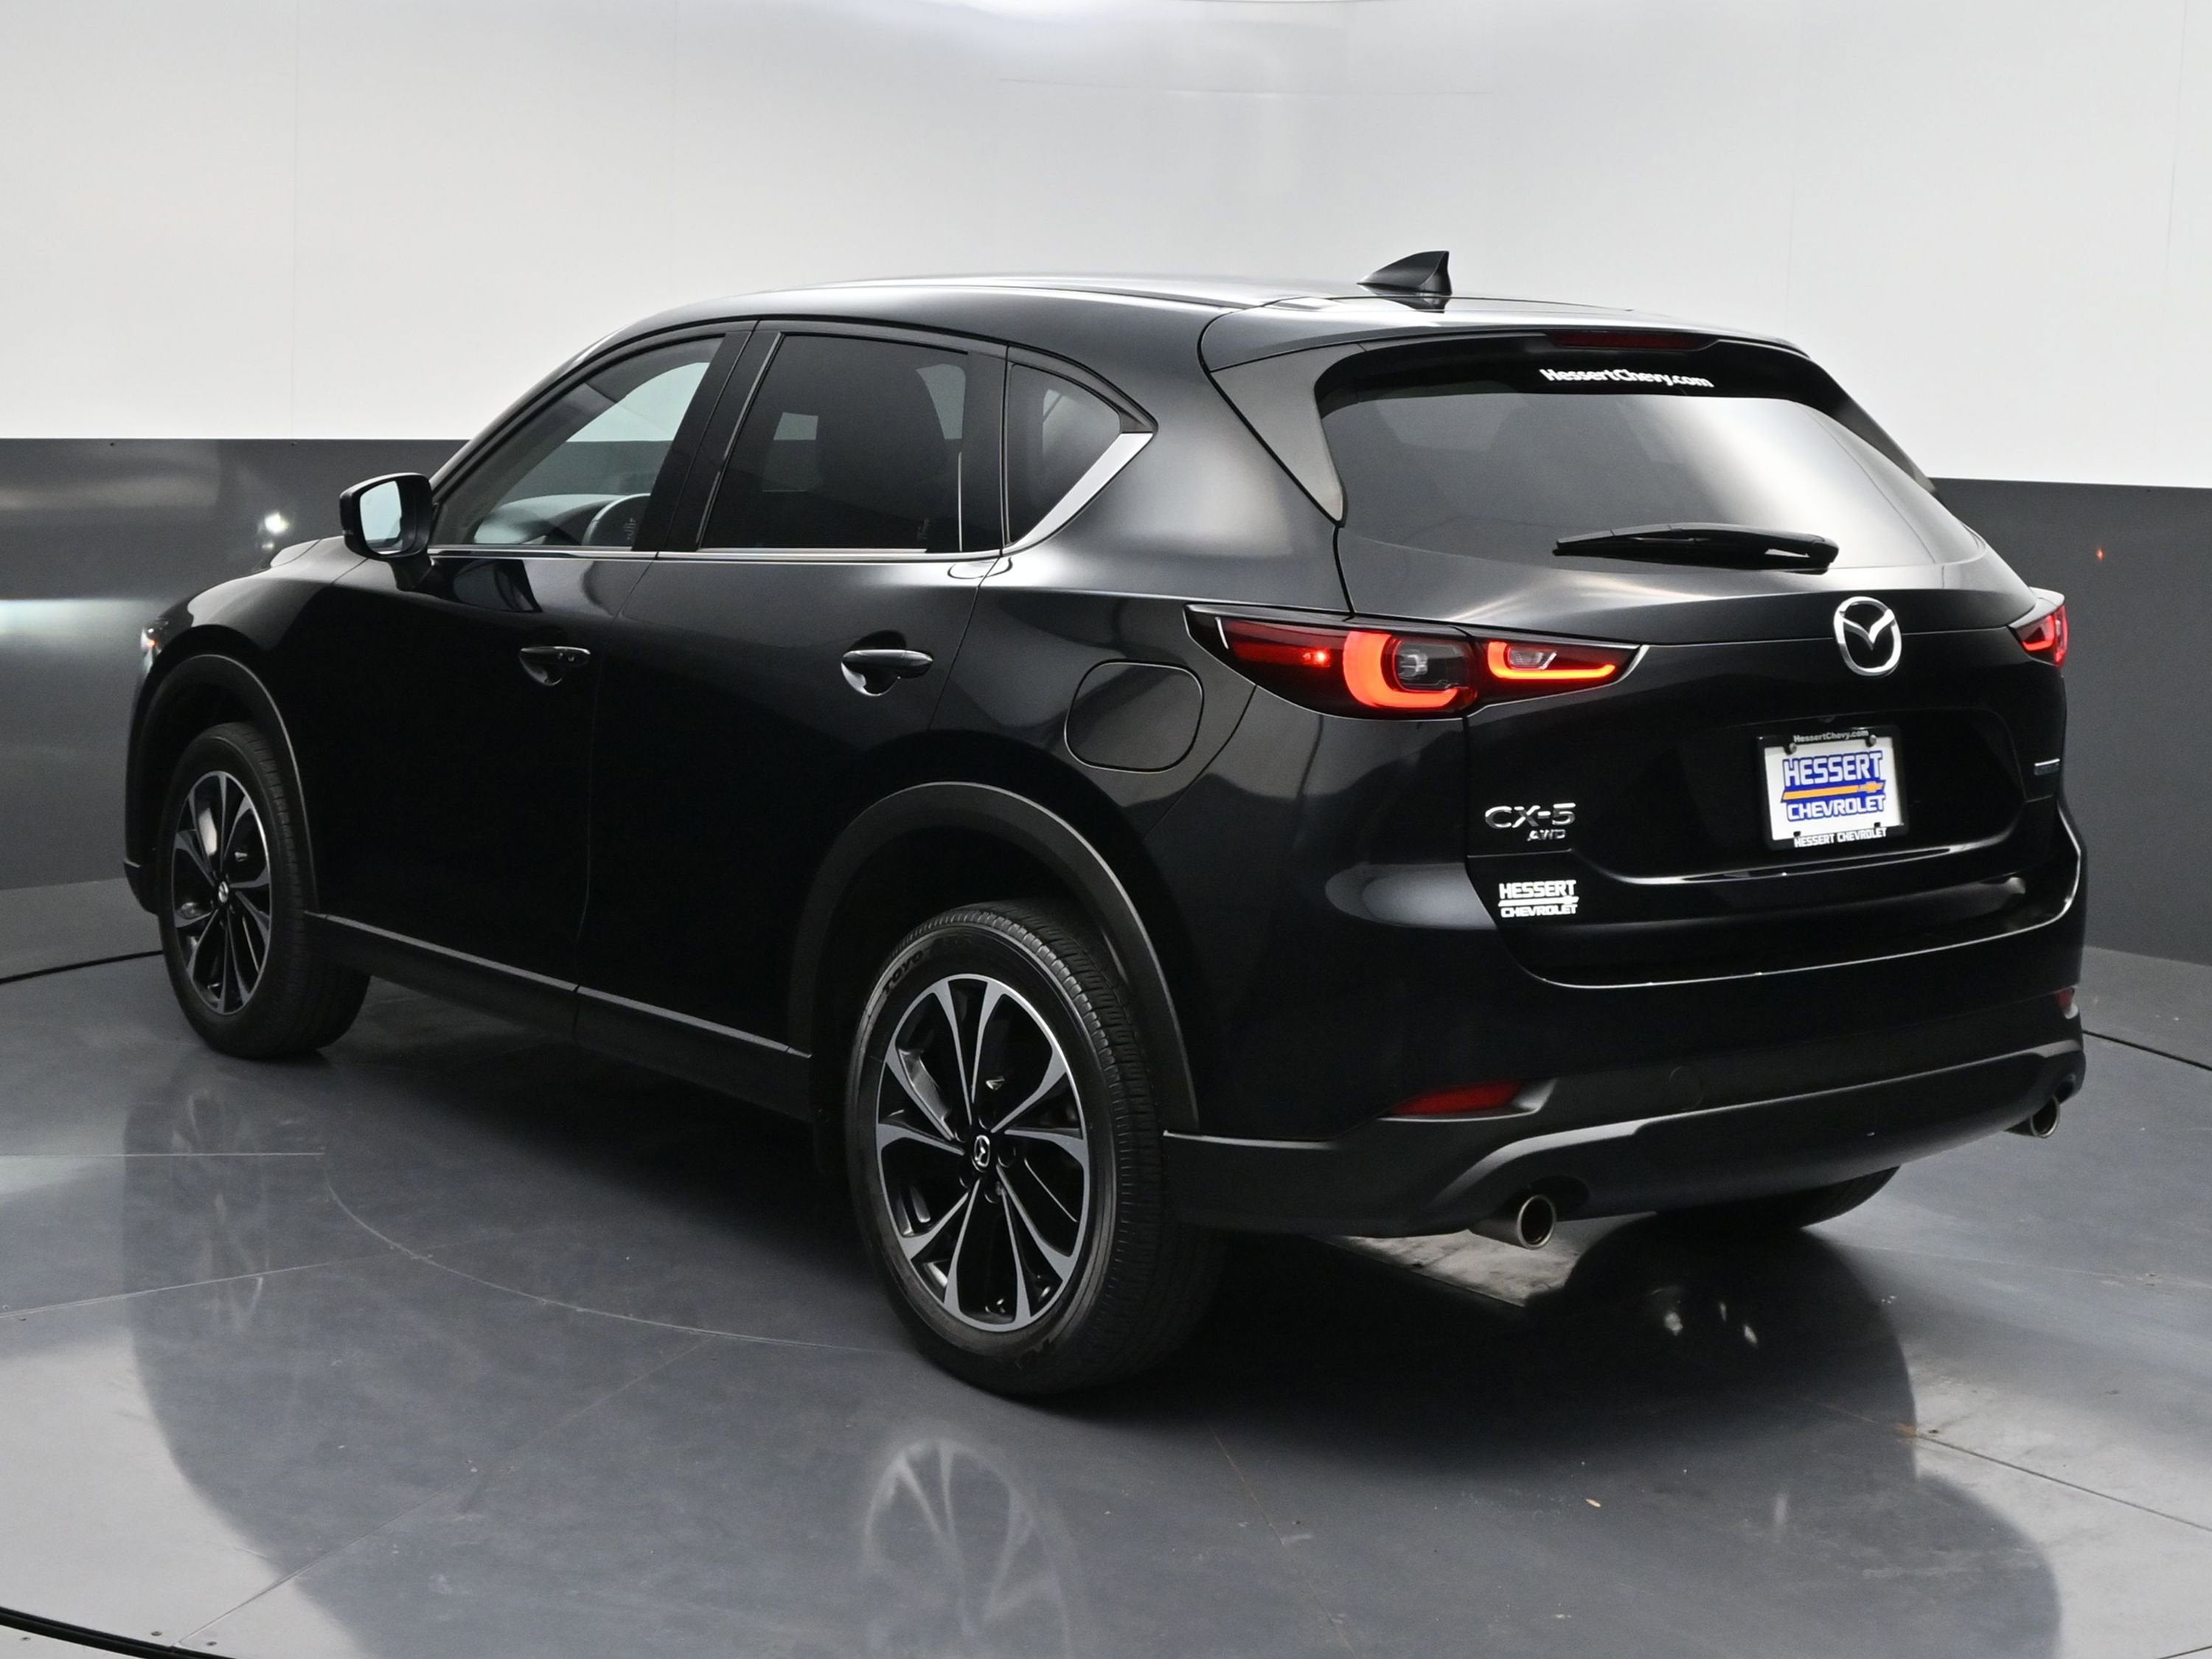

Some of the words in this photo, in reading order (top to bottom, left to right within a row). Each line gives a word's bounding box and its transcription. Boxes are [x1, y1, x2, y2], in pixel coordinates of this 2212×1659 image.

[1539, 369, 1715, 386] HessertChevy.com
[1793, 729, 1869, 742] HessertChevy.com
[1783, 751, 1882, 787] HESSERT
[1485, 802, 1576, 829] CX-5
[1787, 795, 1885, 821] CHEVROLET
[1526, 829, 1566, 841] AWD
[1793, 832, 1834, 848] HESSERT
[1837, 827, 1887, 842] CHEVROLET
[1498, 880, 1577, 900] HESSERT
[1500, 904, 1578, 918] CHEVROLET
[883, 949, 924, 993] TOYO
